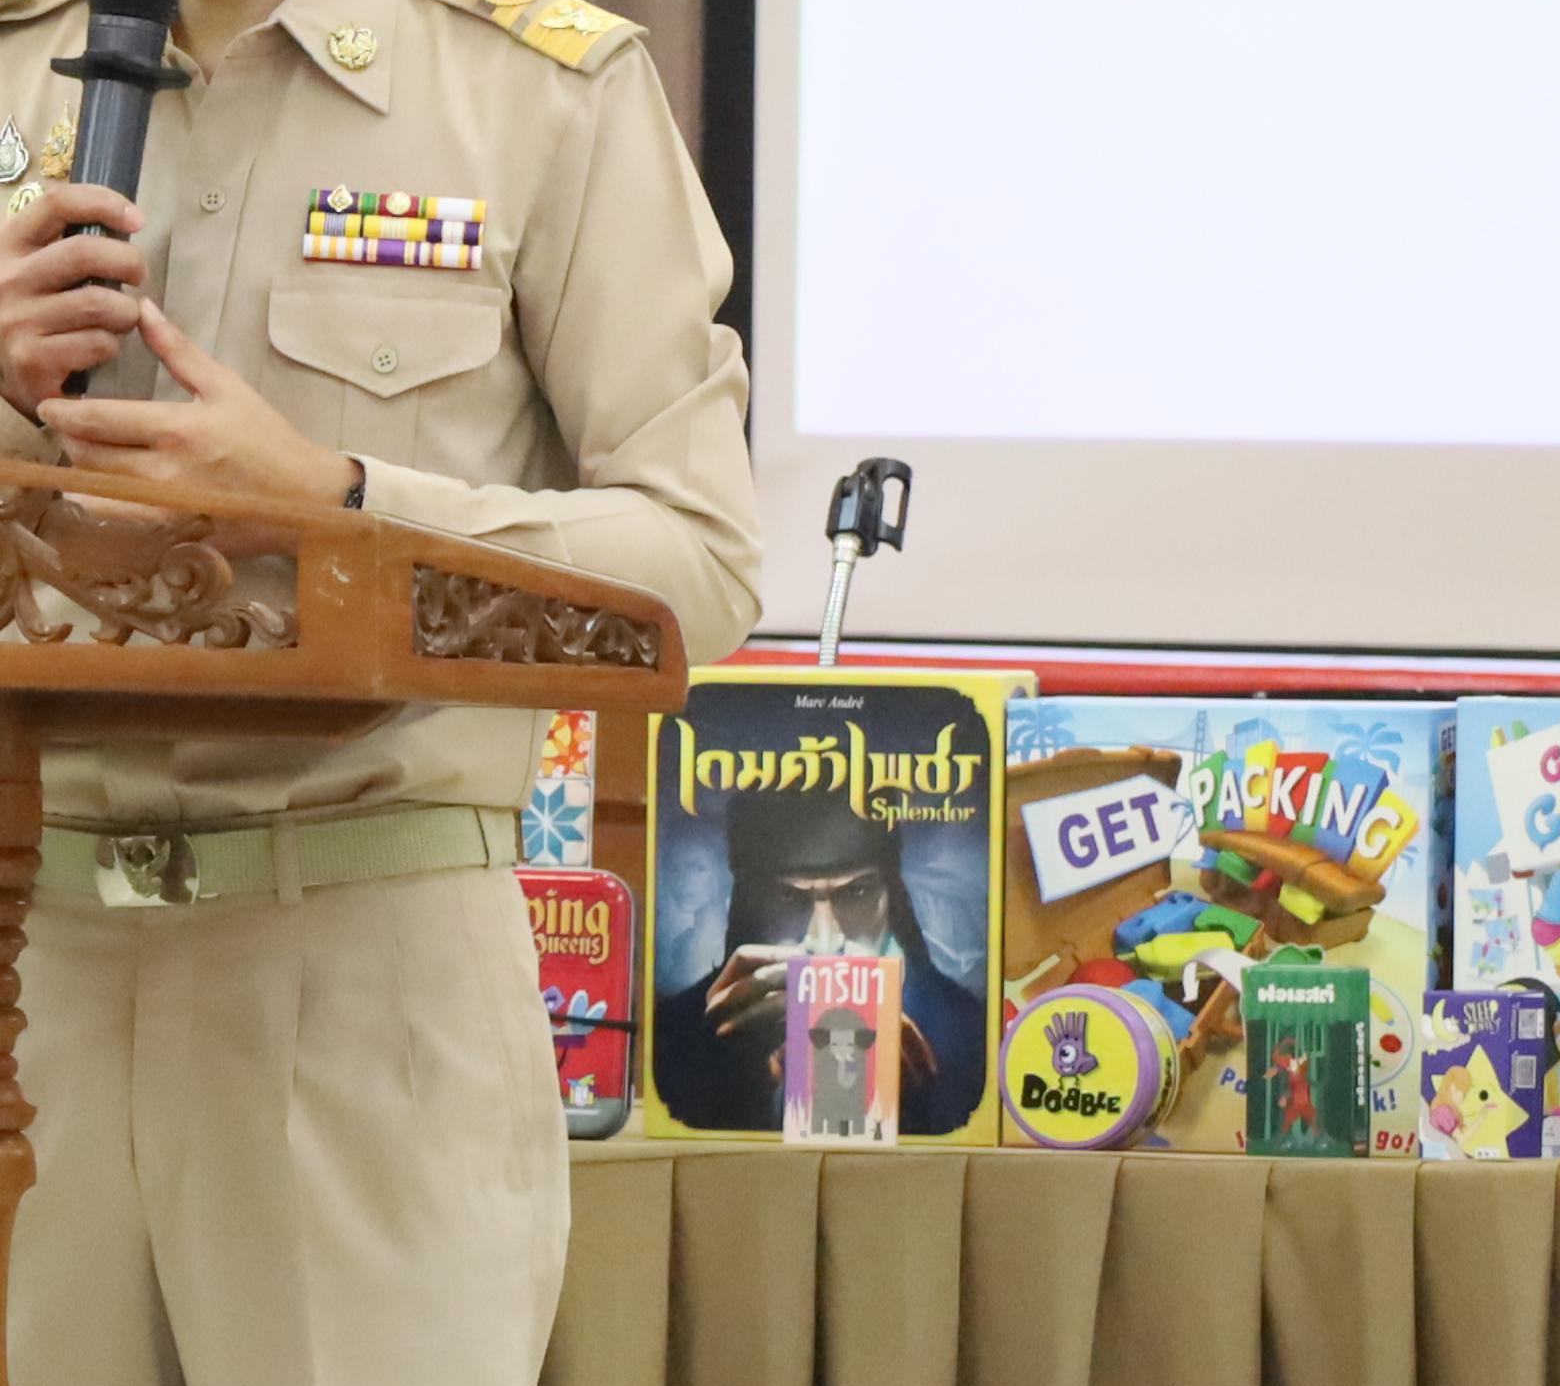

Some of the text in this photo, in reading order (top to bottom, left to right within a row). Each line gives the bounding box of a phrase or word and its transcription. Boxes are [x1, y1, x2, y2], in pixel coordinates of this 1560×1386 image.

[794, 694, 826, 709] Marc
[870, 792, 976, 833] Splendor
[1057, 763, 1400, 869] GET PACKING
